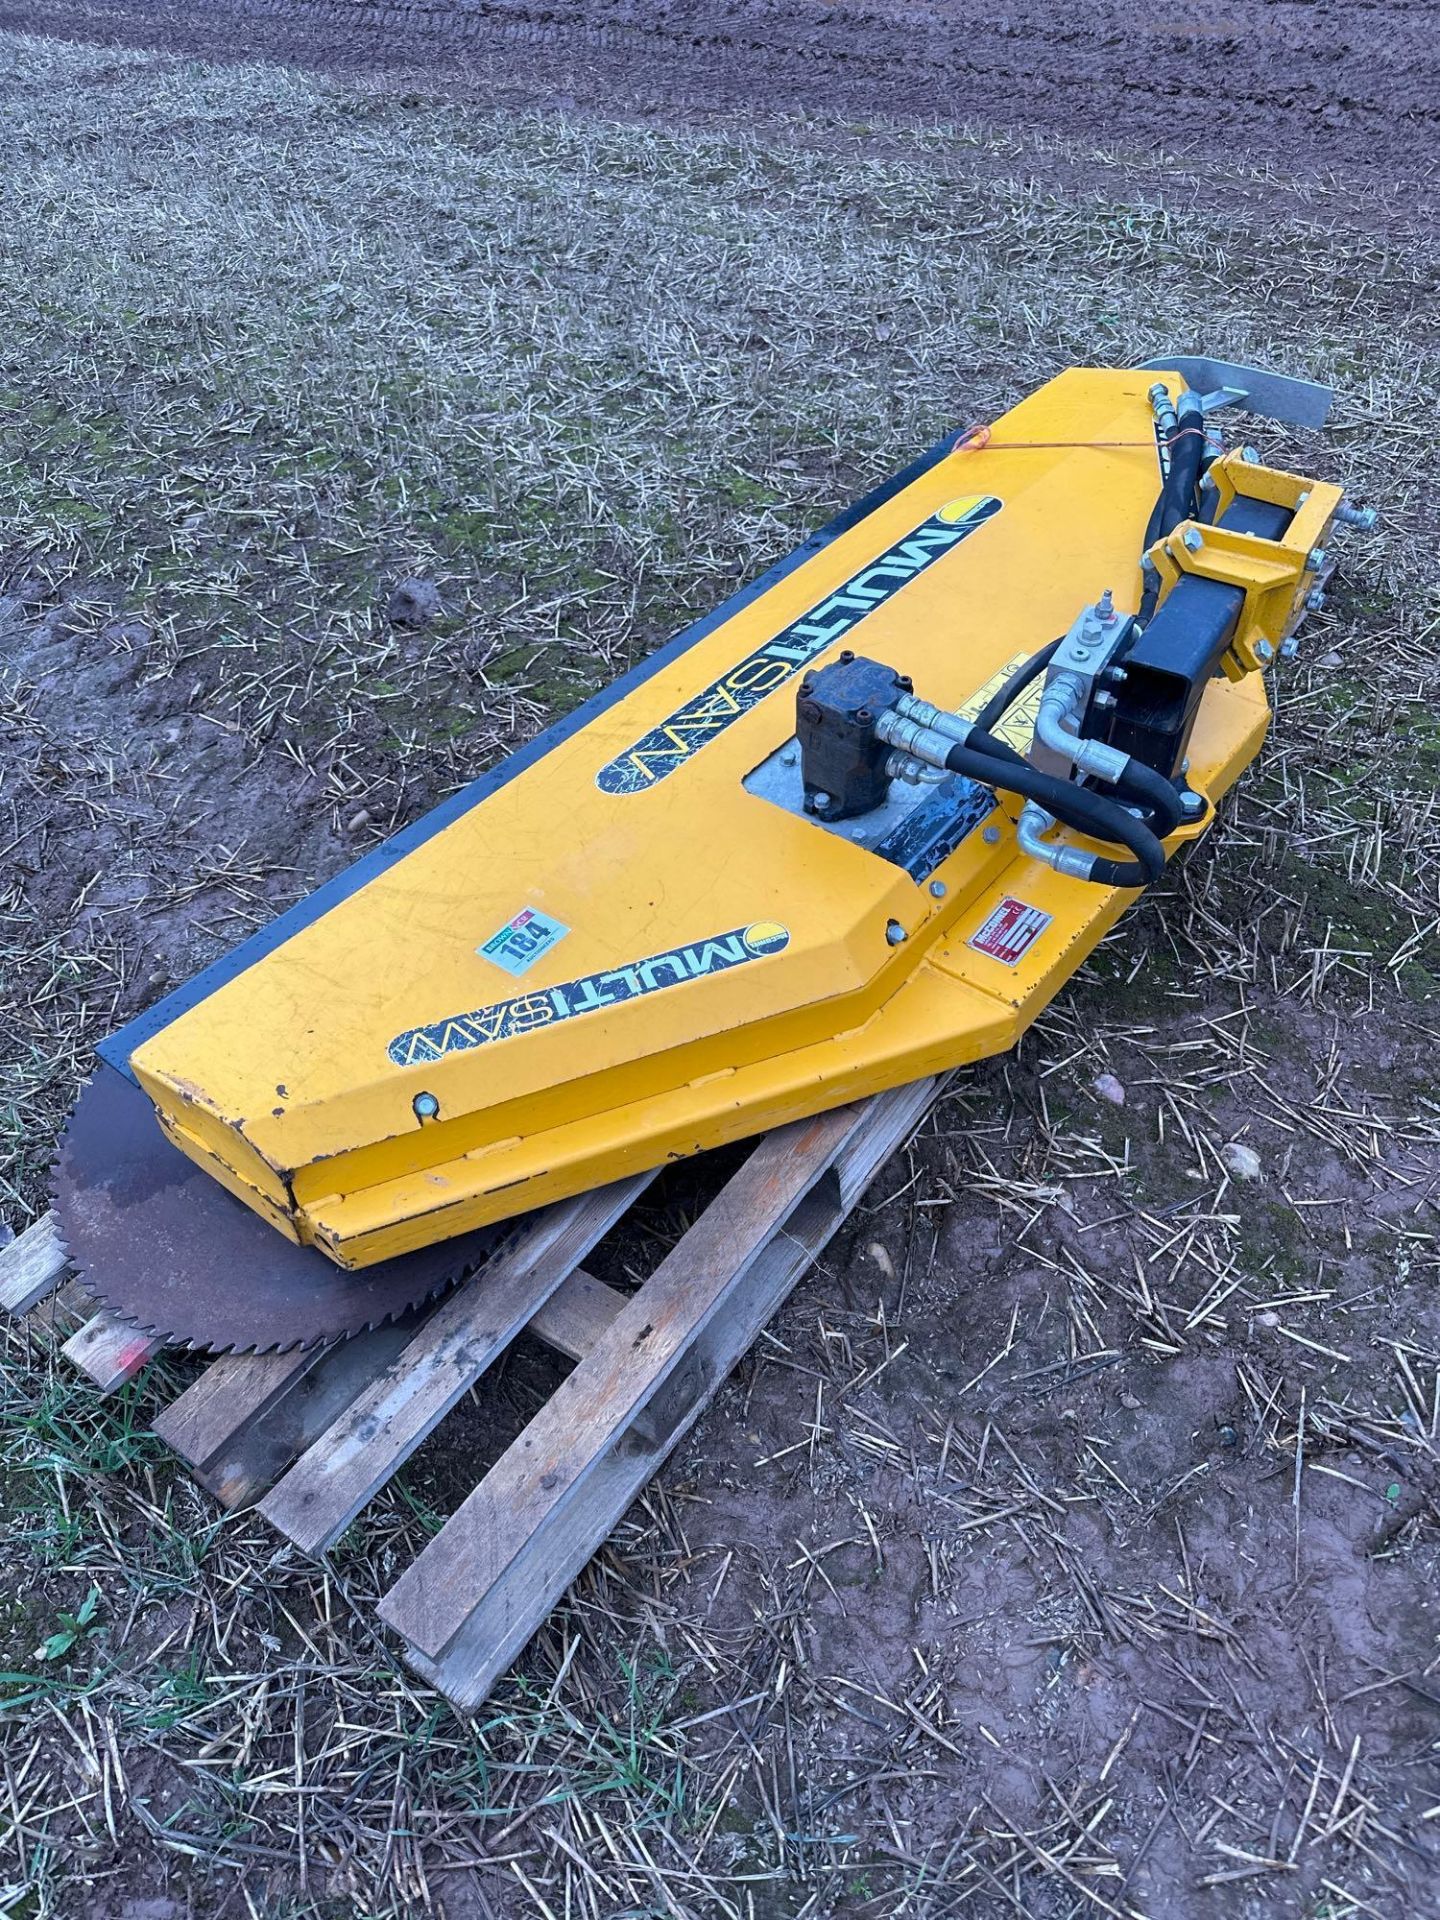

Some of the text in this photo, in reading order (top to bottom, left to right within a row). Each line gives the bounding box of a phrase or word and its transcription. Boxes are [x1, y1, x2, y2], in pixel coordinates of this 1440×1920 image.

[628, 527, 956, 781] MULTISAW
[406, 934, 748, 1064] MULTISAW
[500, 921, 551, 960] 184
